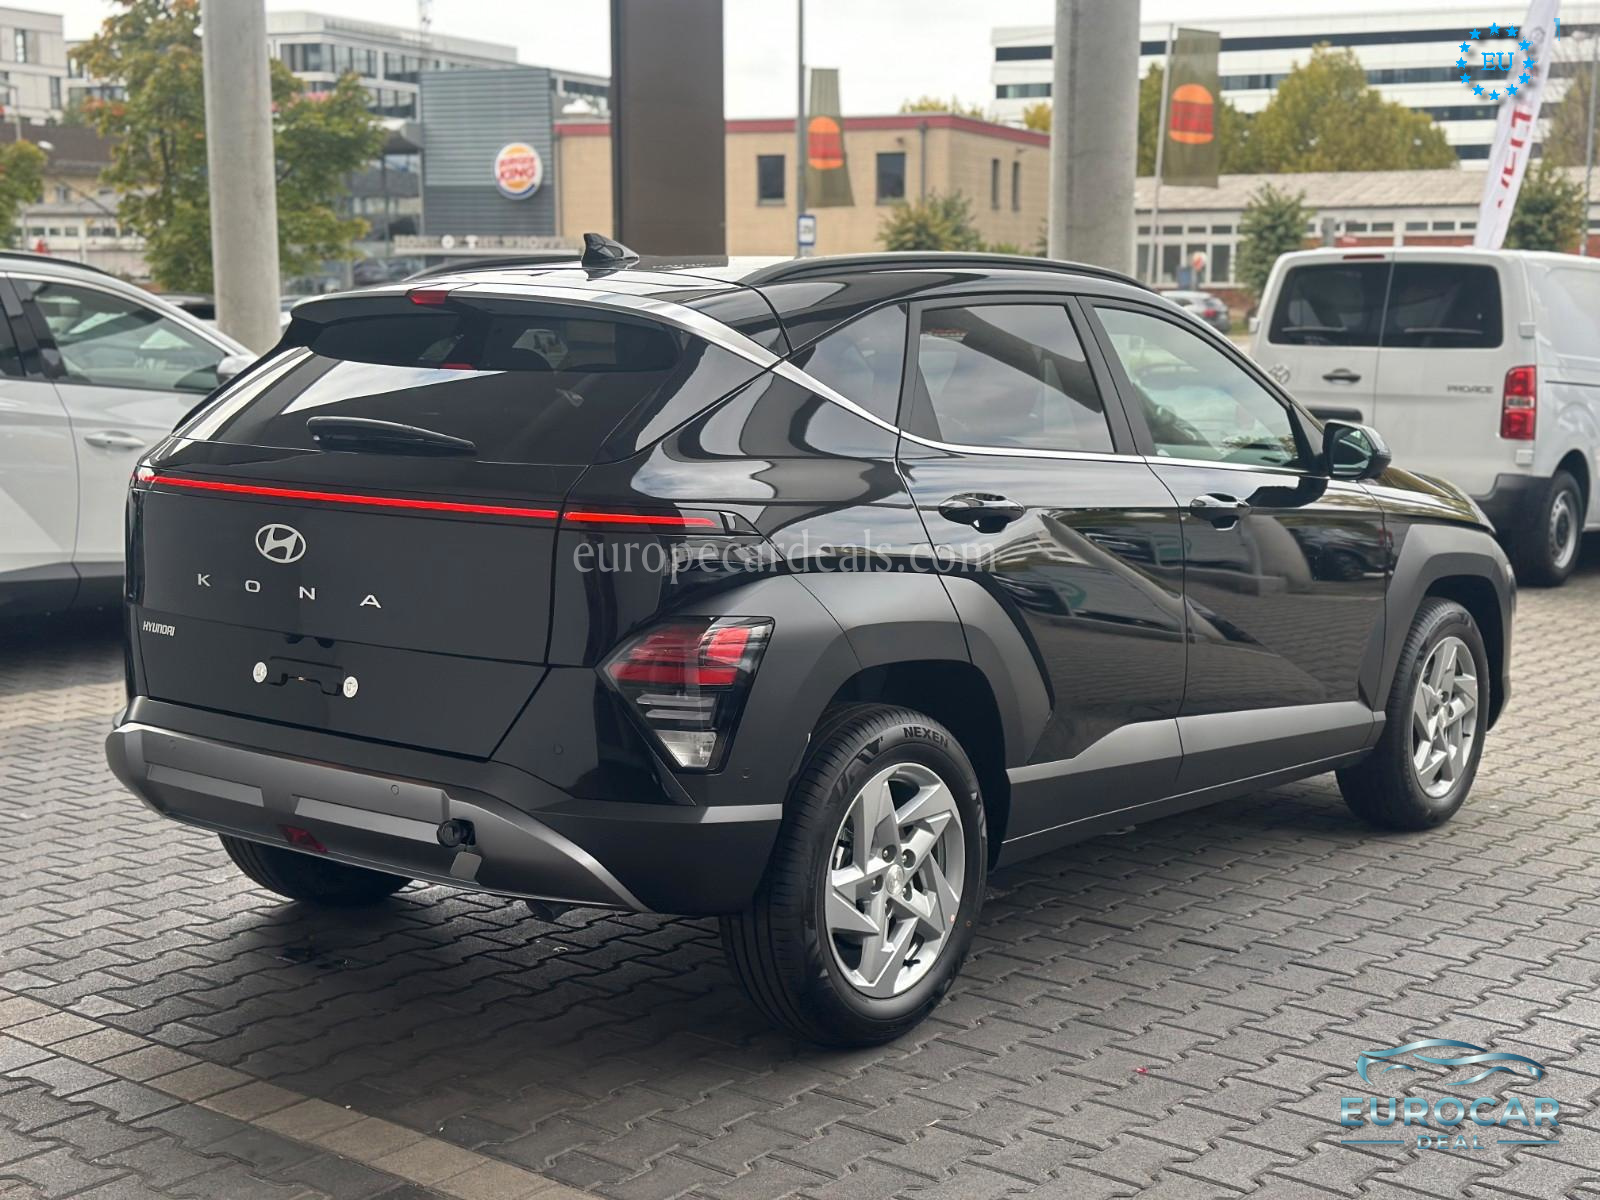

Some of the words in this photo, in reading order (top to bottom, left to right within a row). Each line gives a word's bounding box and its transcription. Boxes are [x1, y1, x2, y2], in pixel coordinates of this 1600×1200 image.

[500, 167, 535, 179] KING
[1447, 385, 1494, 394] PROACE
[196, 573, 382, 608] KONA
[142, 620, 176, 636] HYUNDAI
[903, 726, 949, 748] NEXEN
